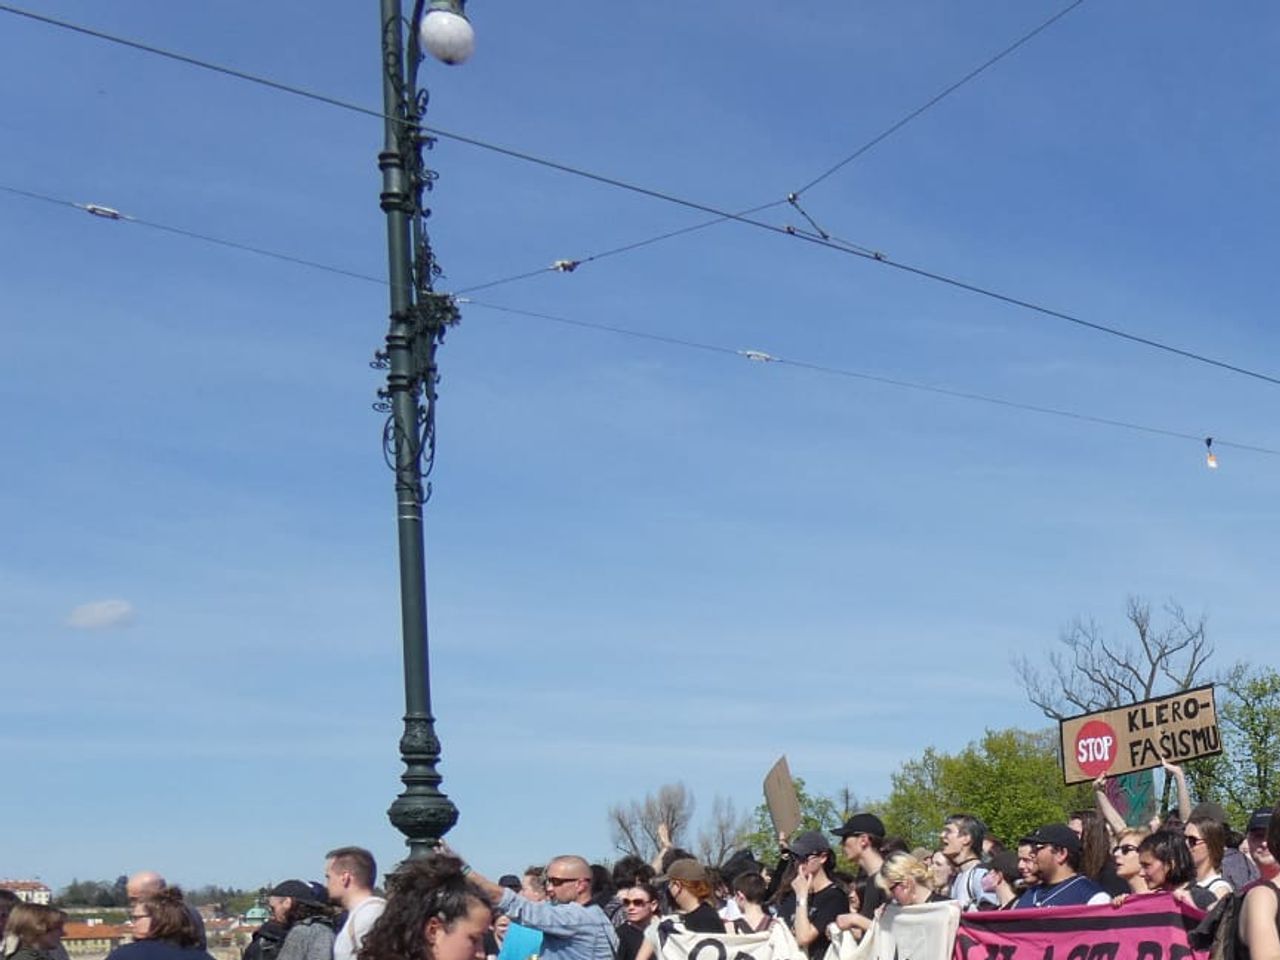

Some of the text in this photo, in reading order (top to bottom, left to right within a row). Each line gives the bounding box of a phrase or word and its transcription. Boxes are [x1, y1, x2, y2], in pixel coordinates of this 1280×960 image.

[1128, 698, 1211, 733] KLERO-
[1078, 736, 1113, 763] STOP
[1129, 726, 1220, 768] FAŠISMU
